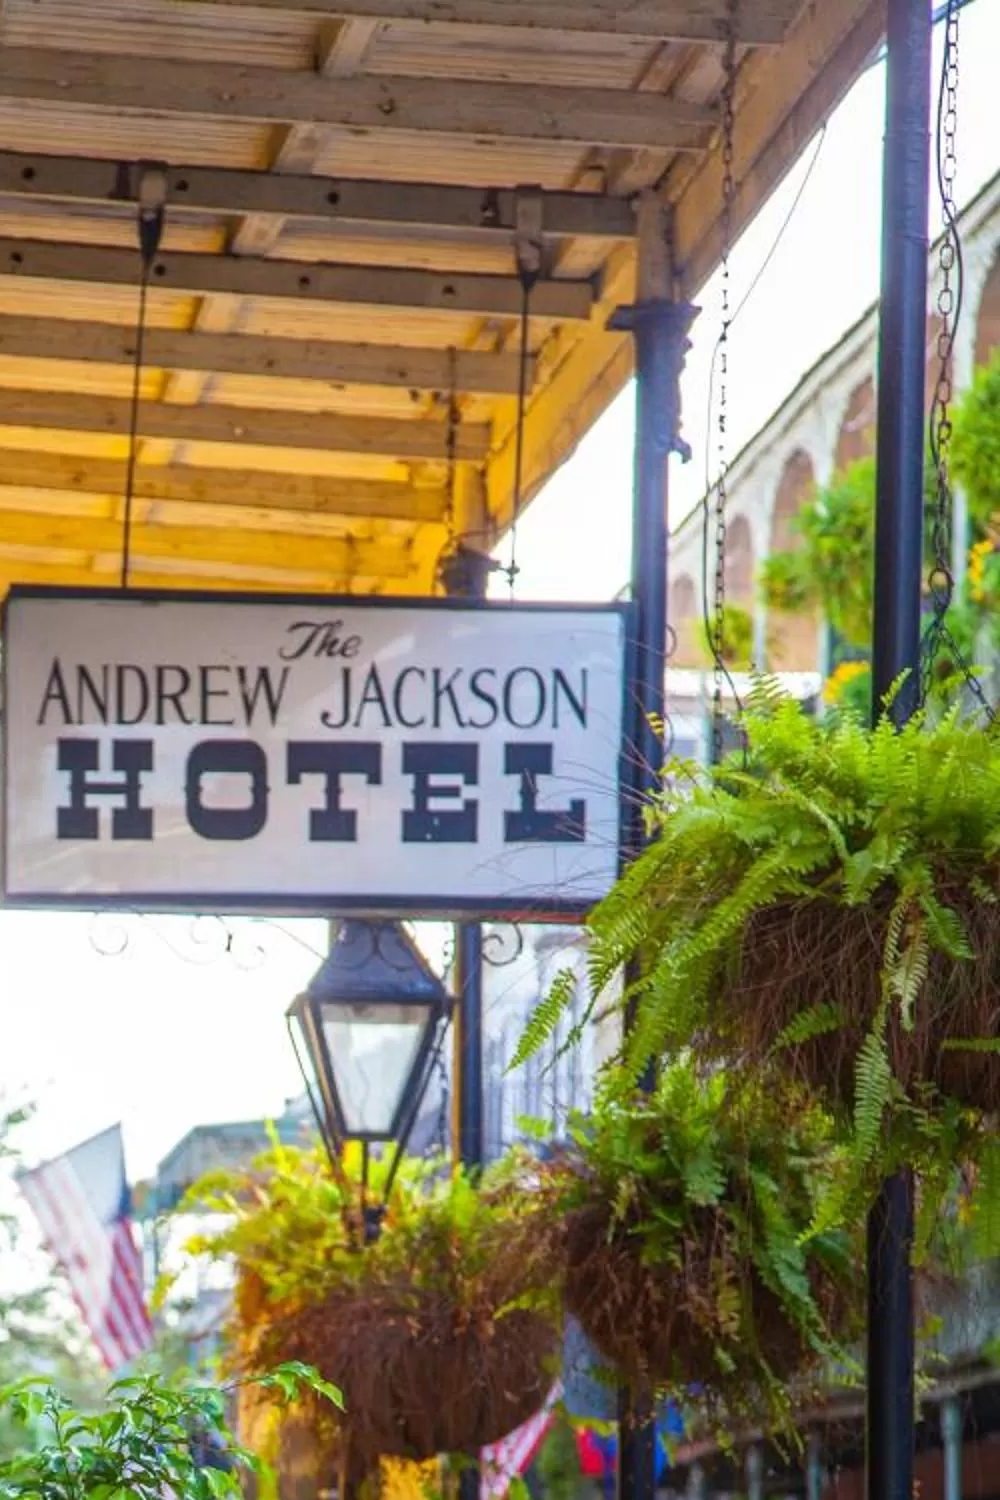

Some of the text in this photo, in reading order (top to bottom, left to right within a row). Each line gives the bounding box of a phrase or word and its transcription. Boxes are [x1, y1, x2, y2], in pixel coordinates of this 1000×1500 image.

[280, 620, 360, 660] The
[37, 657, 589, 728] ANDREW JACKSON
[56, 738, 586, 842] HOTEL
